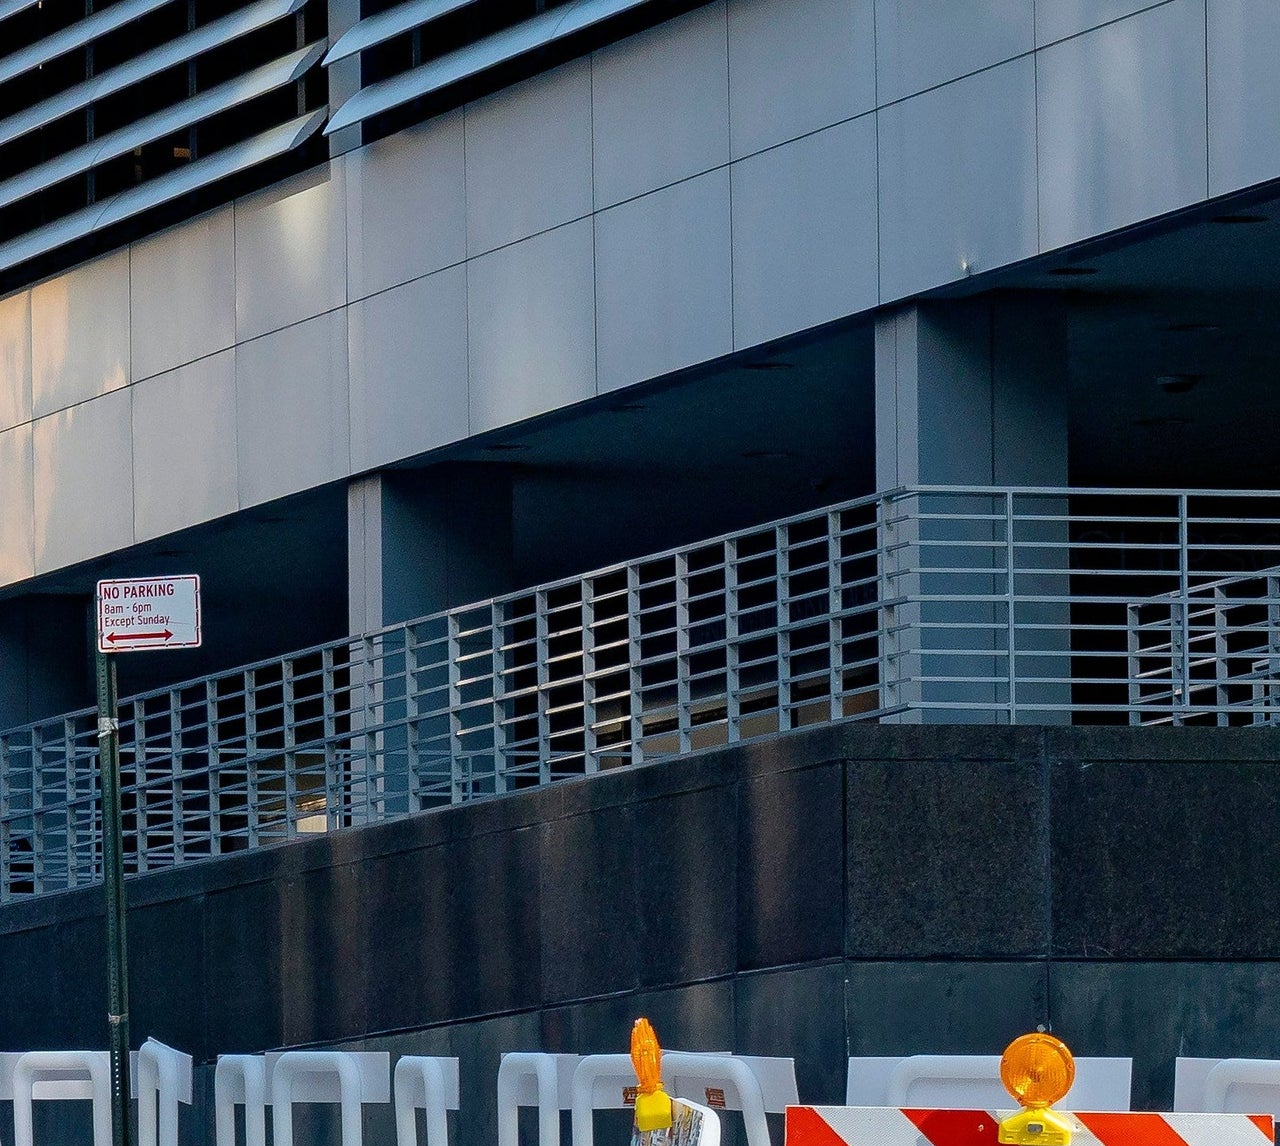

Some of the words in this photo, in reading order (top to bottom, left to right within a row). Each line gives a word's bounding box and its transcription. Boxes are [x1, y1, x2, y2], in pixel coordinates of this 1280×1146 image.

[103, 586, 120, 600] NO
[123, 583, 175, 599] PARKING
[104, 604, 124, 615] 8am
[132, 602, 152, 615] 6pm
[104, 615, 135, 628] Except
[137, 614, 170, 626] Sunday
